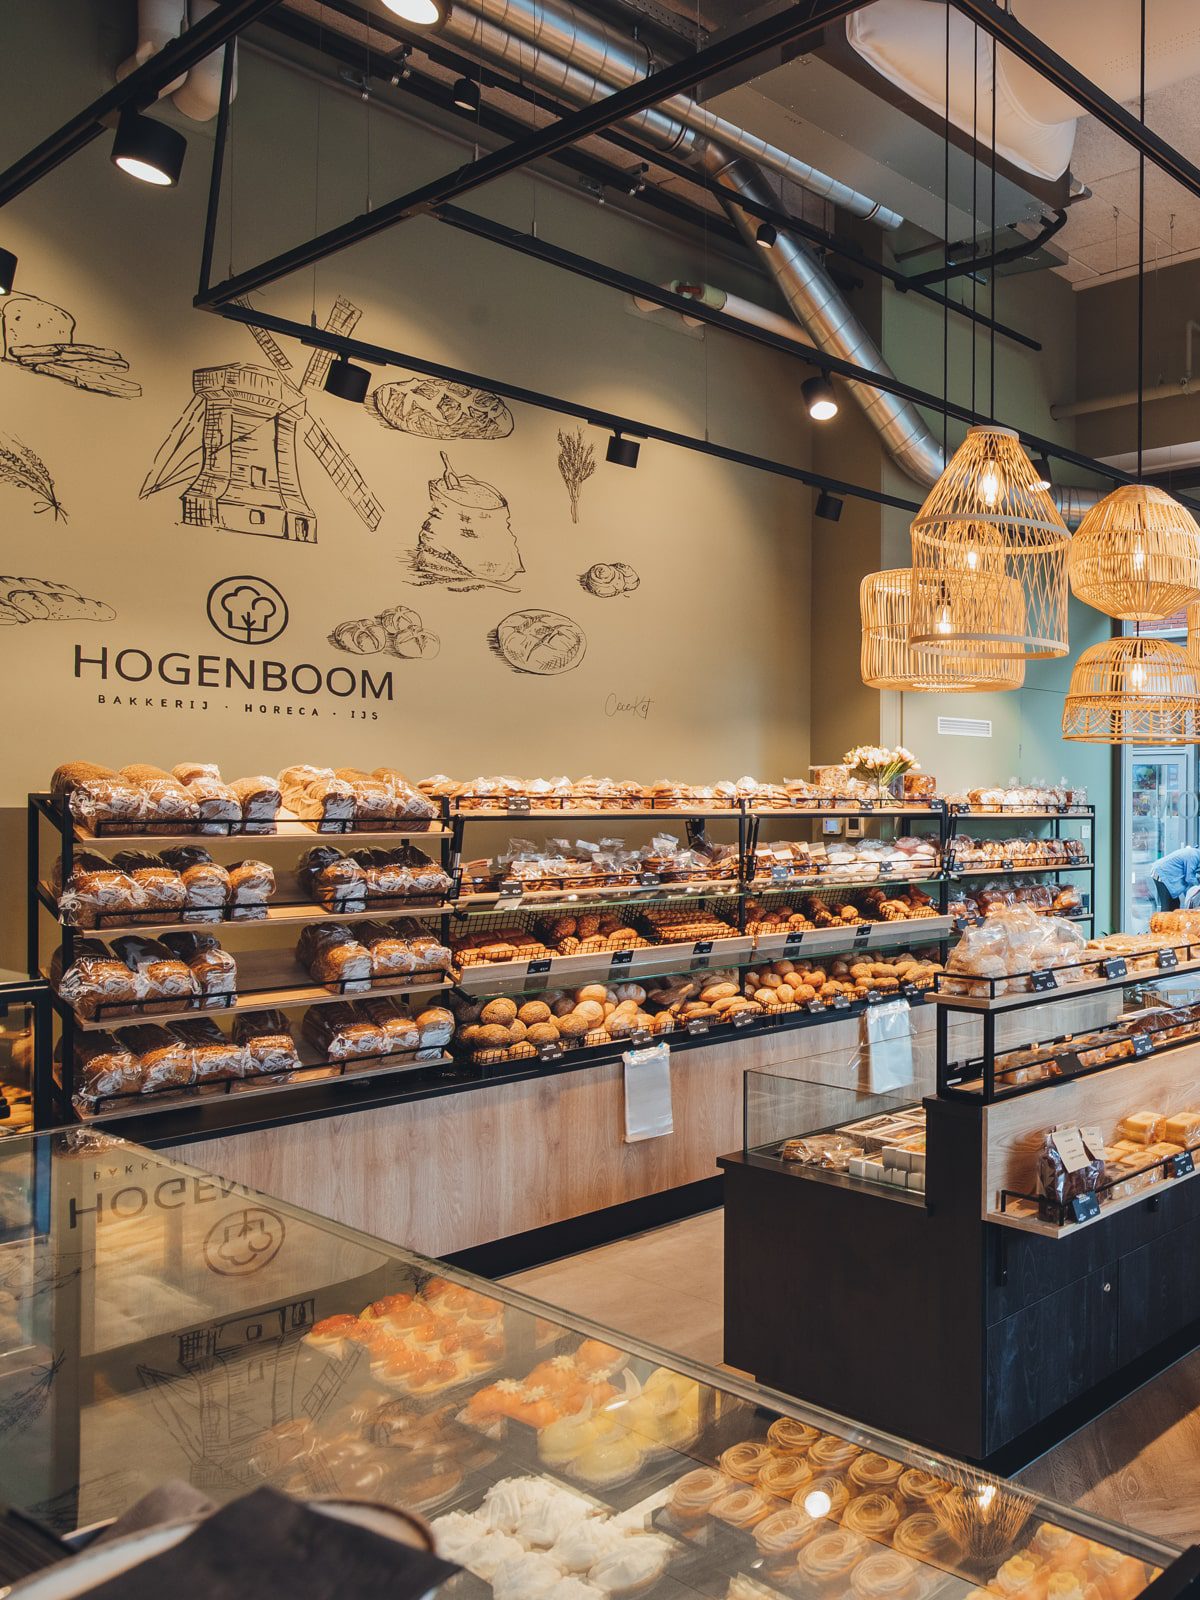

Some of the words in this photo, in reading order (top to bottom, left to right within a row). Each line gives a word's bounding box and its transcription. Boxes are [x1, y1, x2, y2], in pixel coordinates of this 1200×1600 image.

[74, 644, 394, 701] HOGENBOOM
[98, 694, 209, 711] BAKKERIJ
[244, 703, 319, 717] HORECA
[351, 710, 379, 720] IJS
